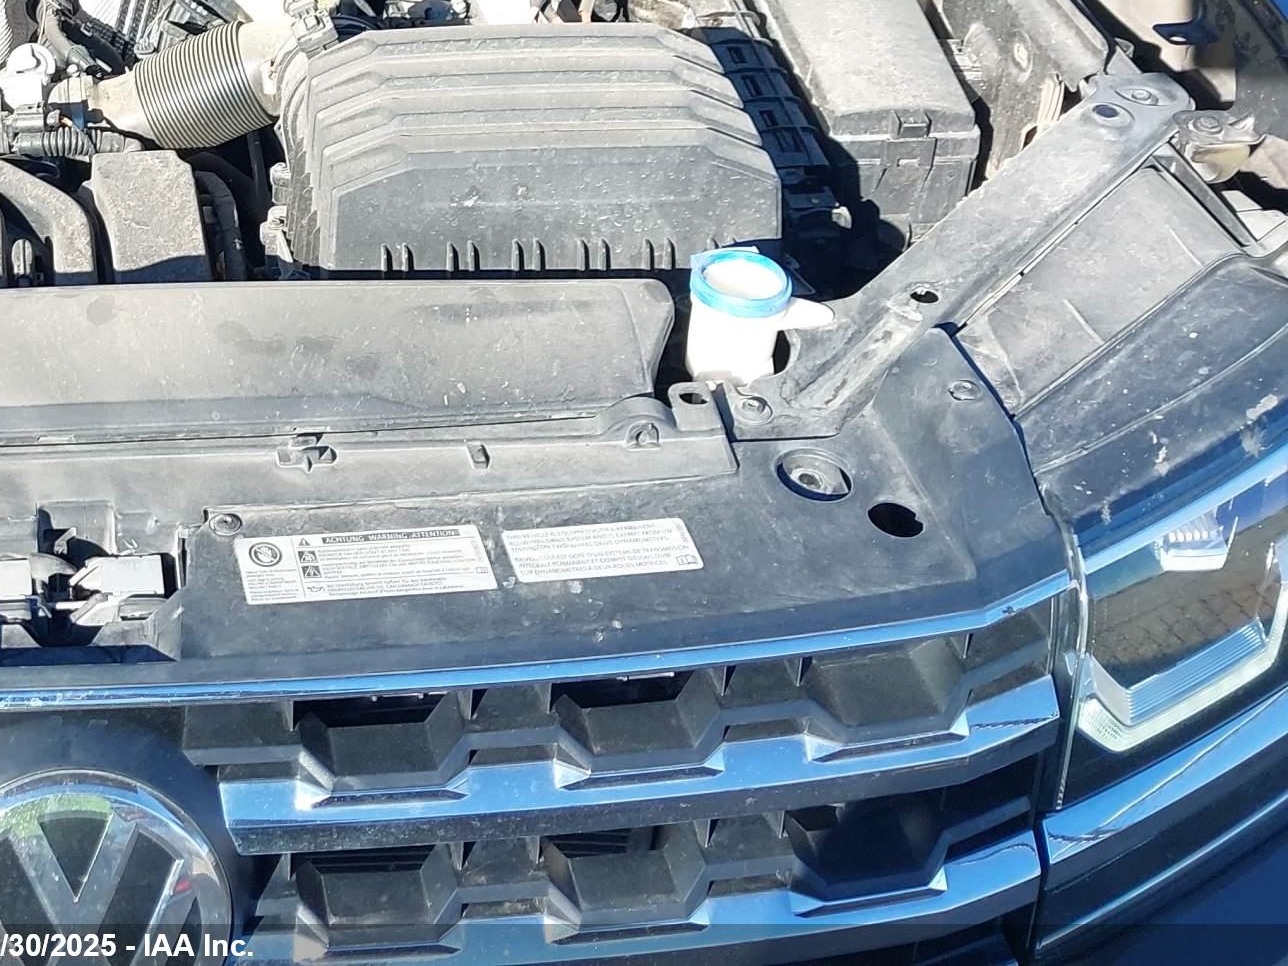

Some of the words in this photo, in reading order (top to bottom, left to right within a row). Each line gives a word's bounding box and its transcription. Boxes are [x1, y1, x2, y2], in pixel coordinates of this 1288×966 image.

[325, 535, 365, 544] ACHTUNG
[368, 532, 408, 541] WARNING
[411, 529, 455, 539] ATTENTION
